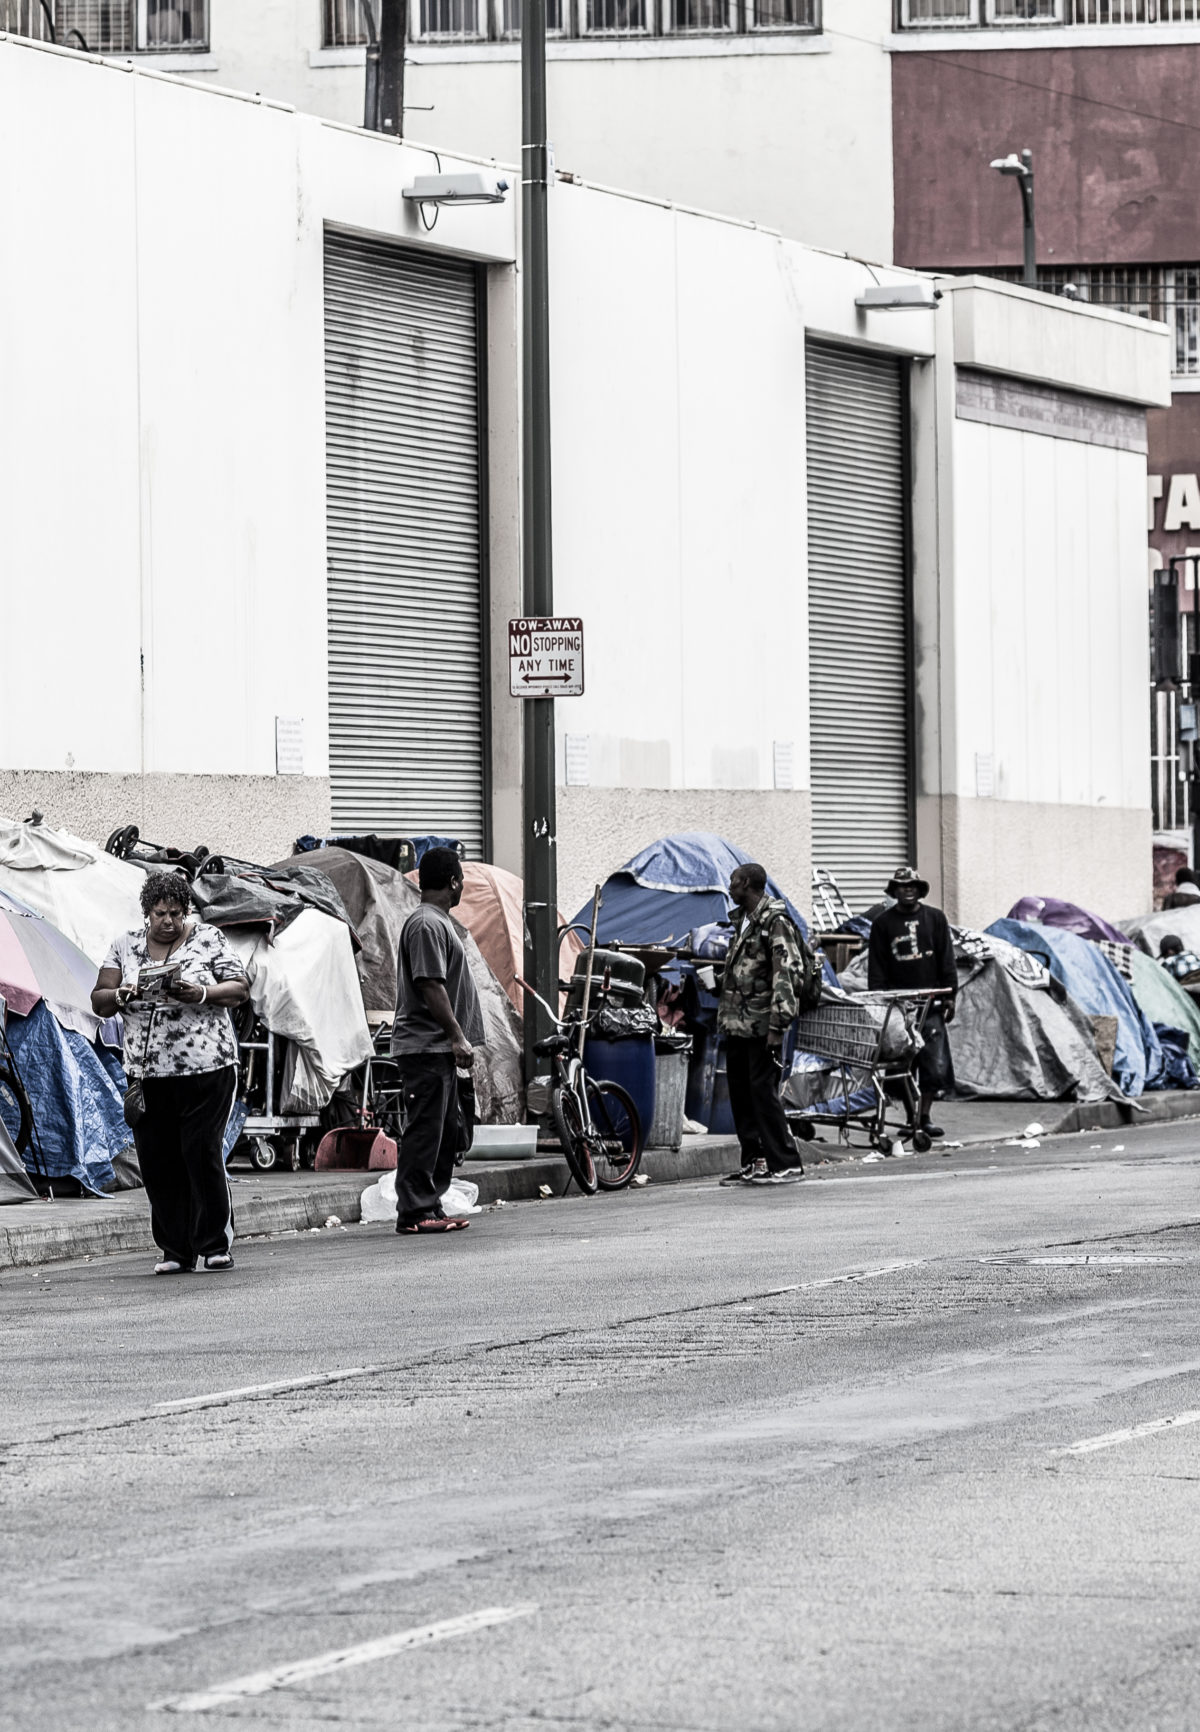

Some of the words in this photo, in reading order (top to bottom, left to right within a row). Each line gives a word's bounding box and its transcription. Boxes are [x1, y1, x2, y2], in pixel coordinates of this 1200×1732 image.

[511, 620, 580, 631] TOW-AWAY
[510, 634, 531, 655] NO
[533, 636, 580, 652] STOPPING
[518, 659, 542, 672] ANY
[548, 658, 575, 671] TIME
